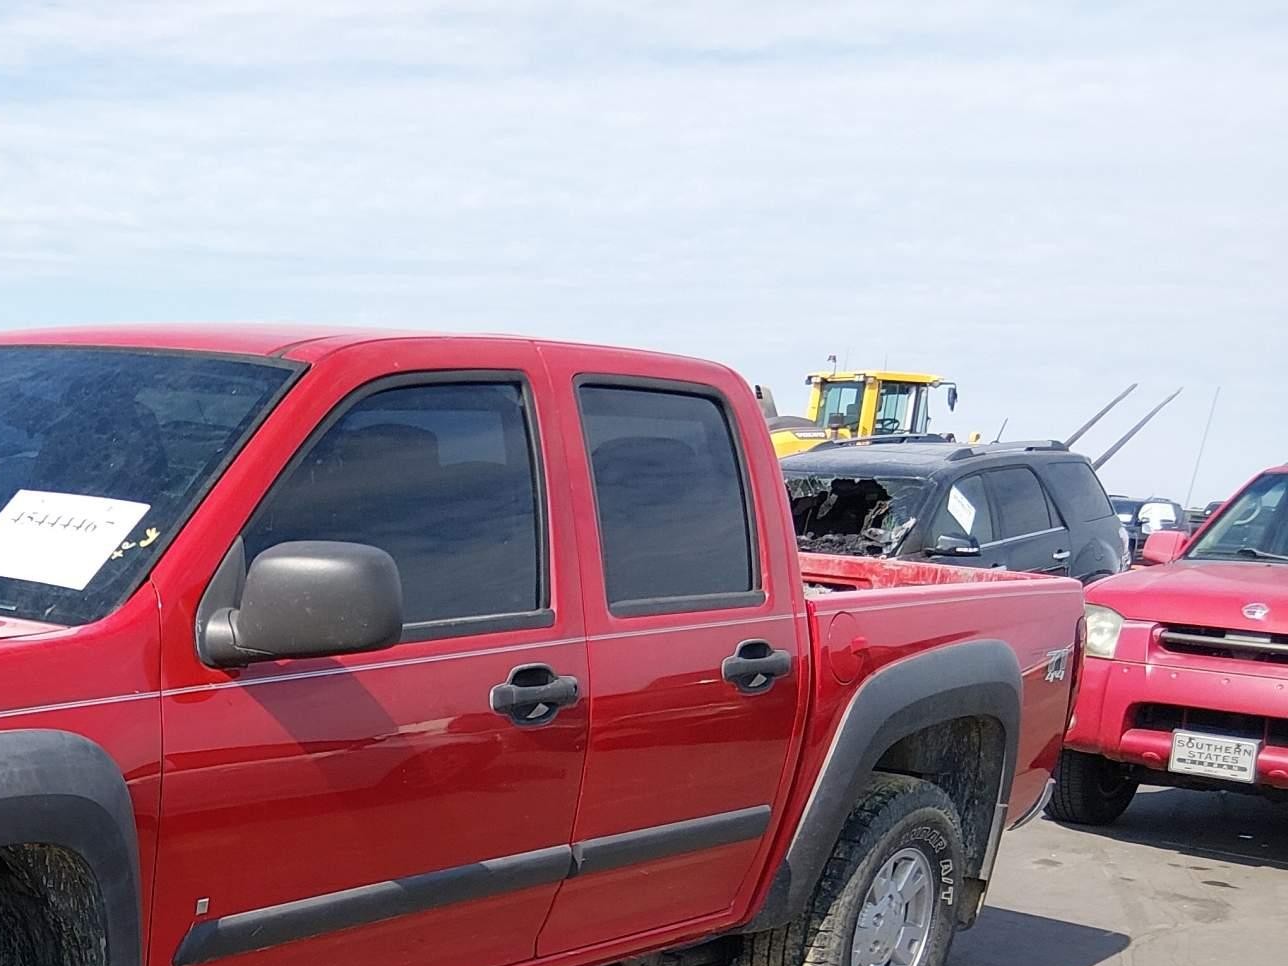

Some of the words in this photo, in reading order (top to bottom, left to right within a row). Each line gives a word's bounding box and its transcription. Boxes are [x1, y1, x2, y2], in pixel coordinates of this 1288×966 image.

[1177, 739, 1252, 757] SOUTHERN
[1187, 751, 1239, 765] STATES
[939, 859, 954, 906] A/T
